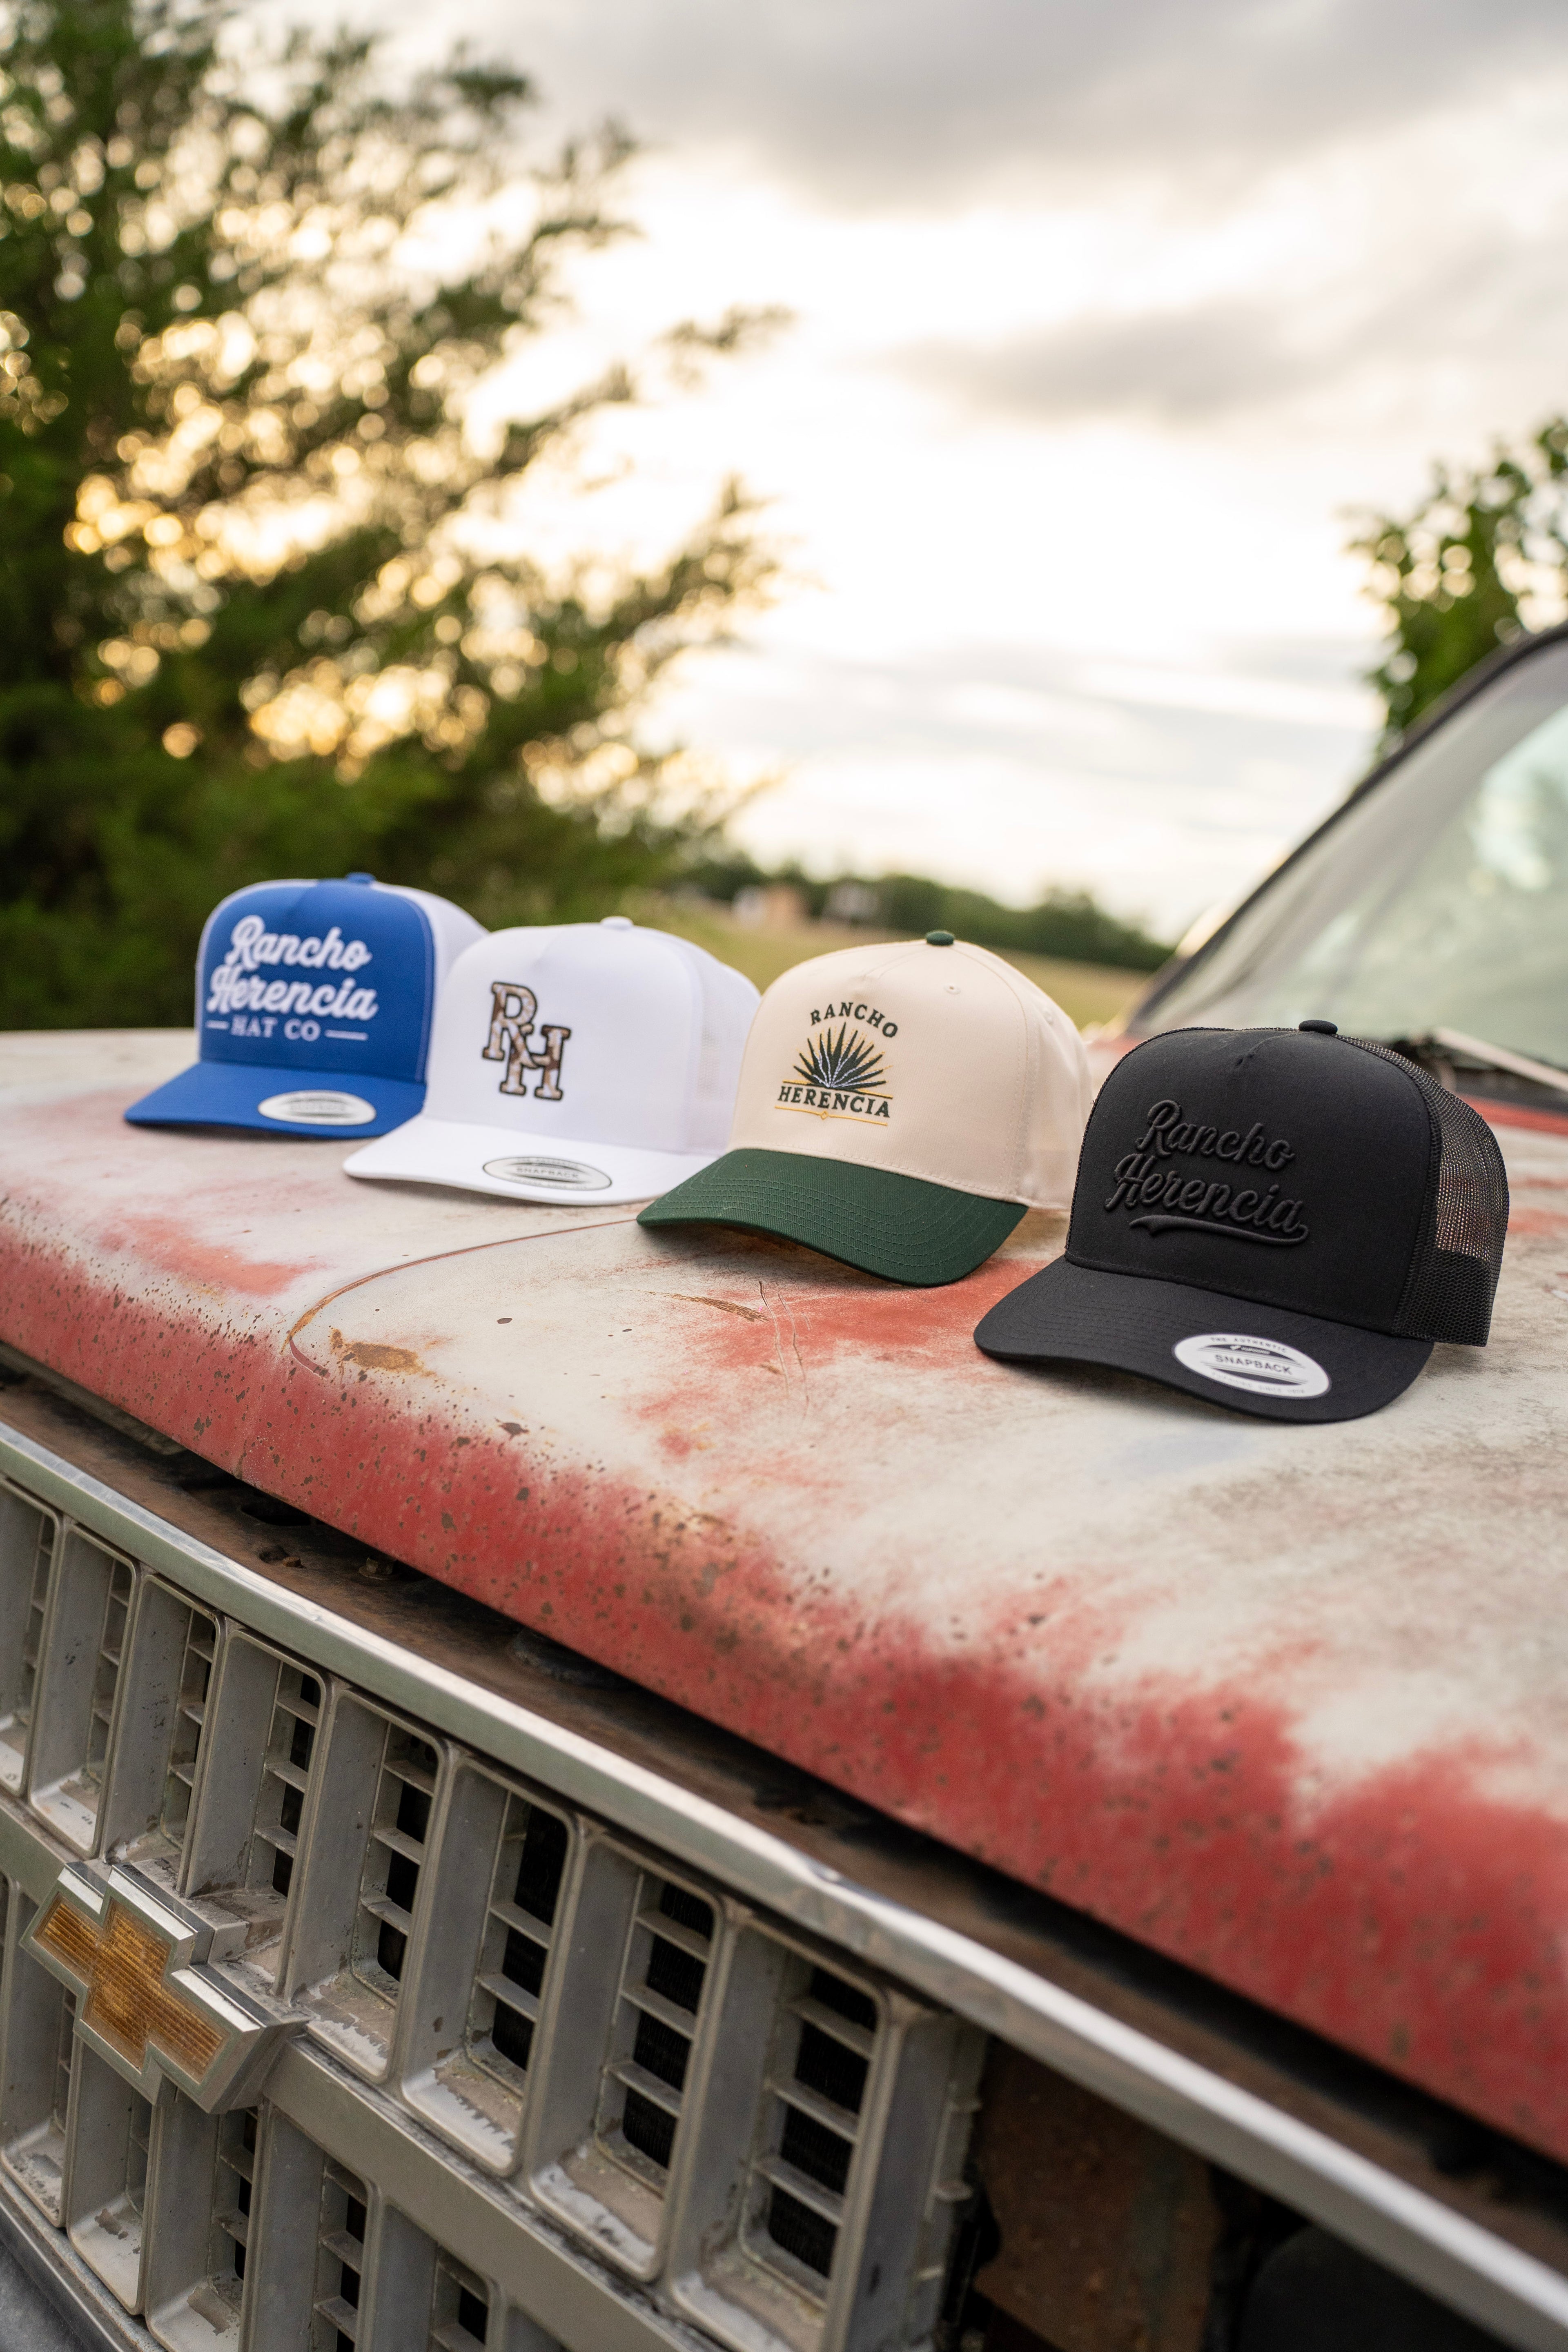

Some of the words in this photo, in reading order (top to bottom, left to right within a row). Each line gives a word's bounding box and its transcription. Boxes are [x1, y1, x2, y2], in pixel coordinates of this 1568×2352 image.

[225, 914, 372, 972] Rancho
[207, 964, 379, 1021] Herencia
[231, 1014, 278, 1038] HAT
[283, 1018, 321, 1042] CO
[810, 1002, 898, 1038] RANCHO
[777, 1086, 890, 1118] HERENCIA
[1136, 1099, 1295, 1171] Rancho
[1104, 1153, 1304, 1234] Herencia
[1214, 1354, 1292, 1375] SNAPBACK
